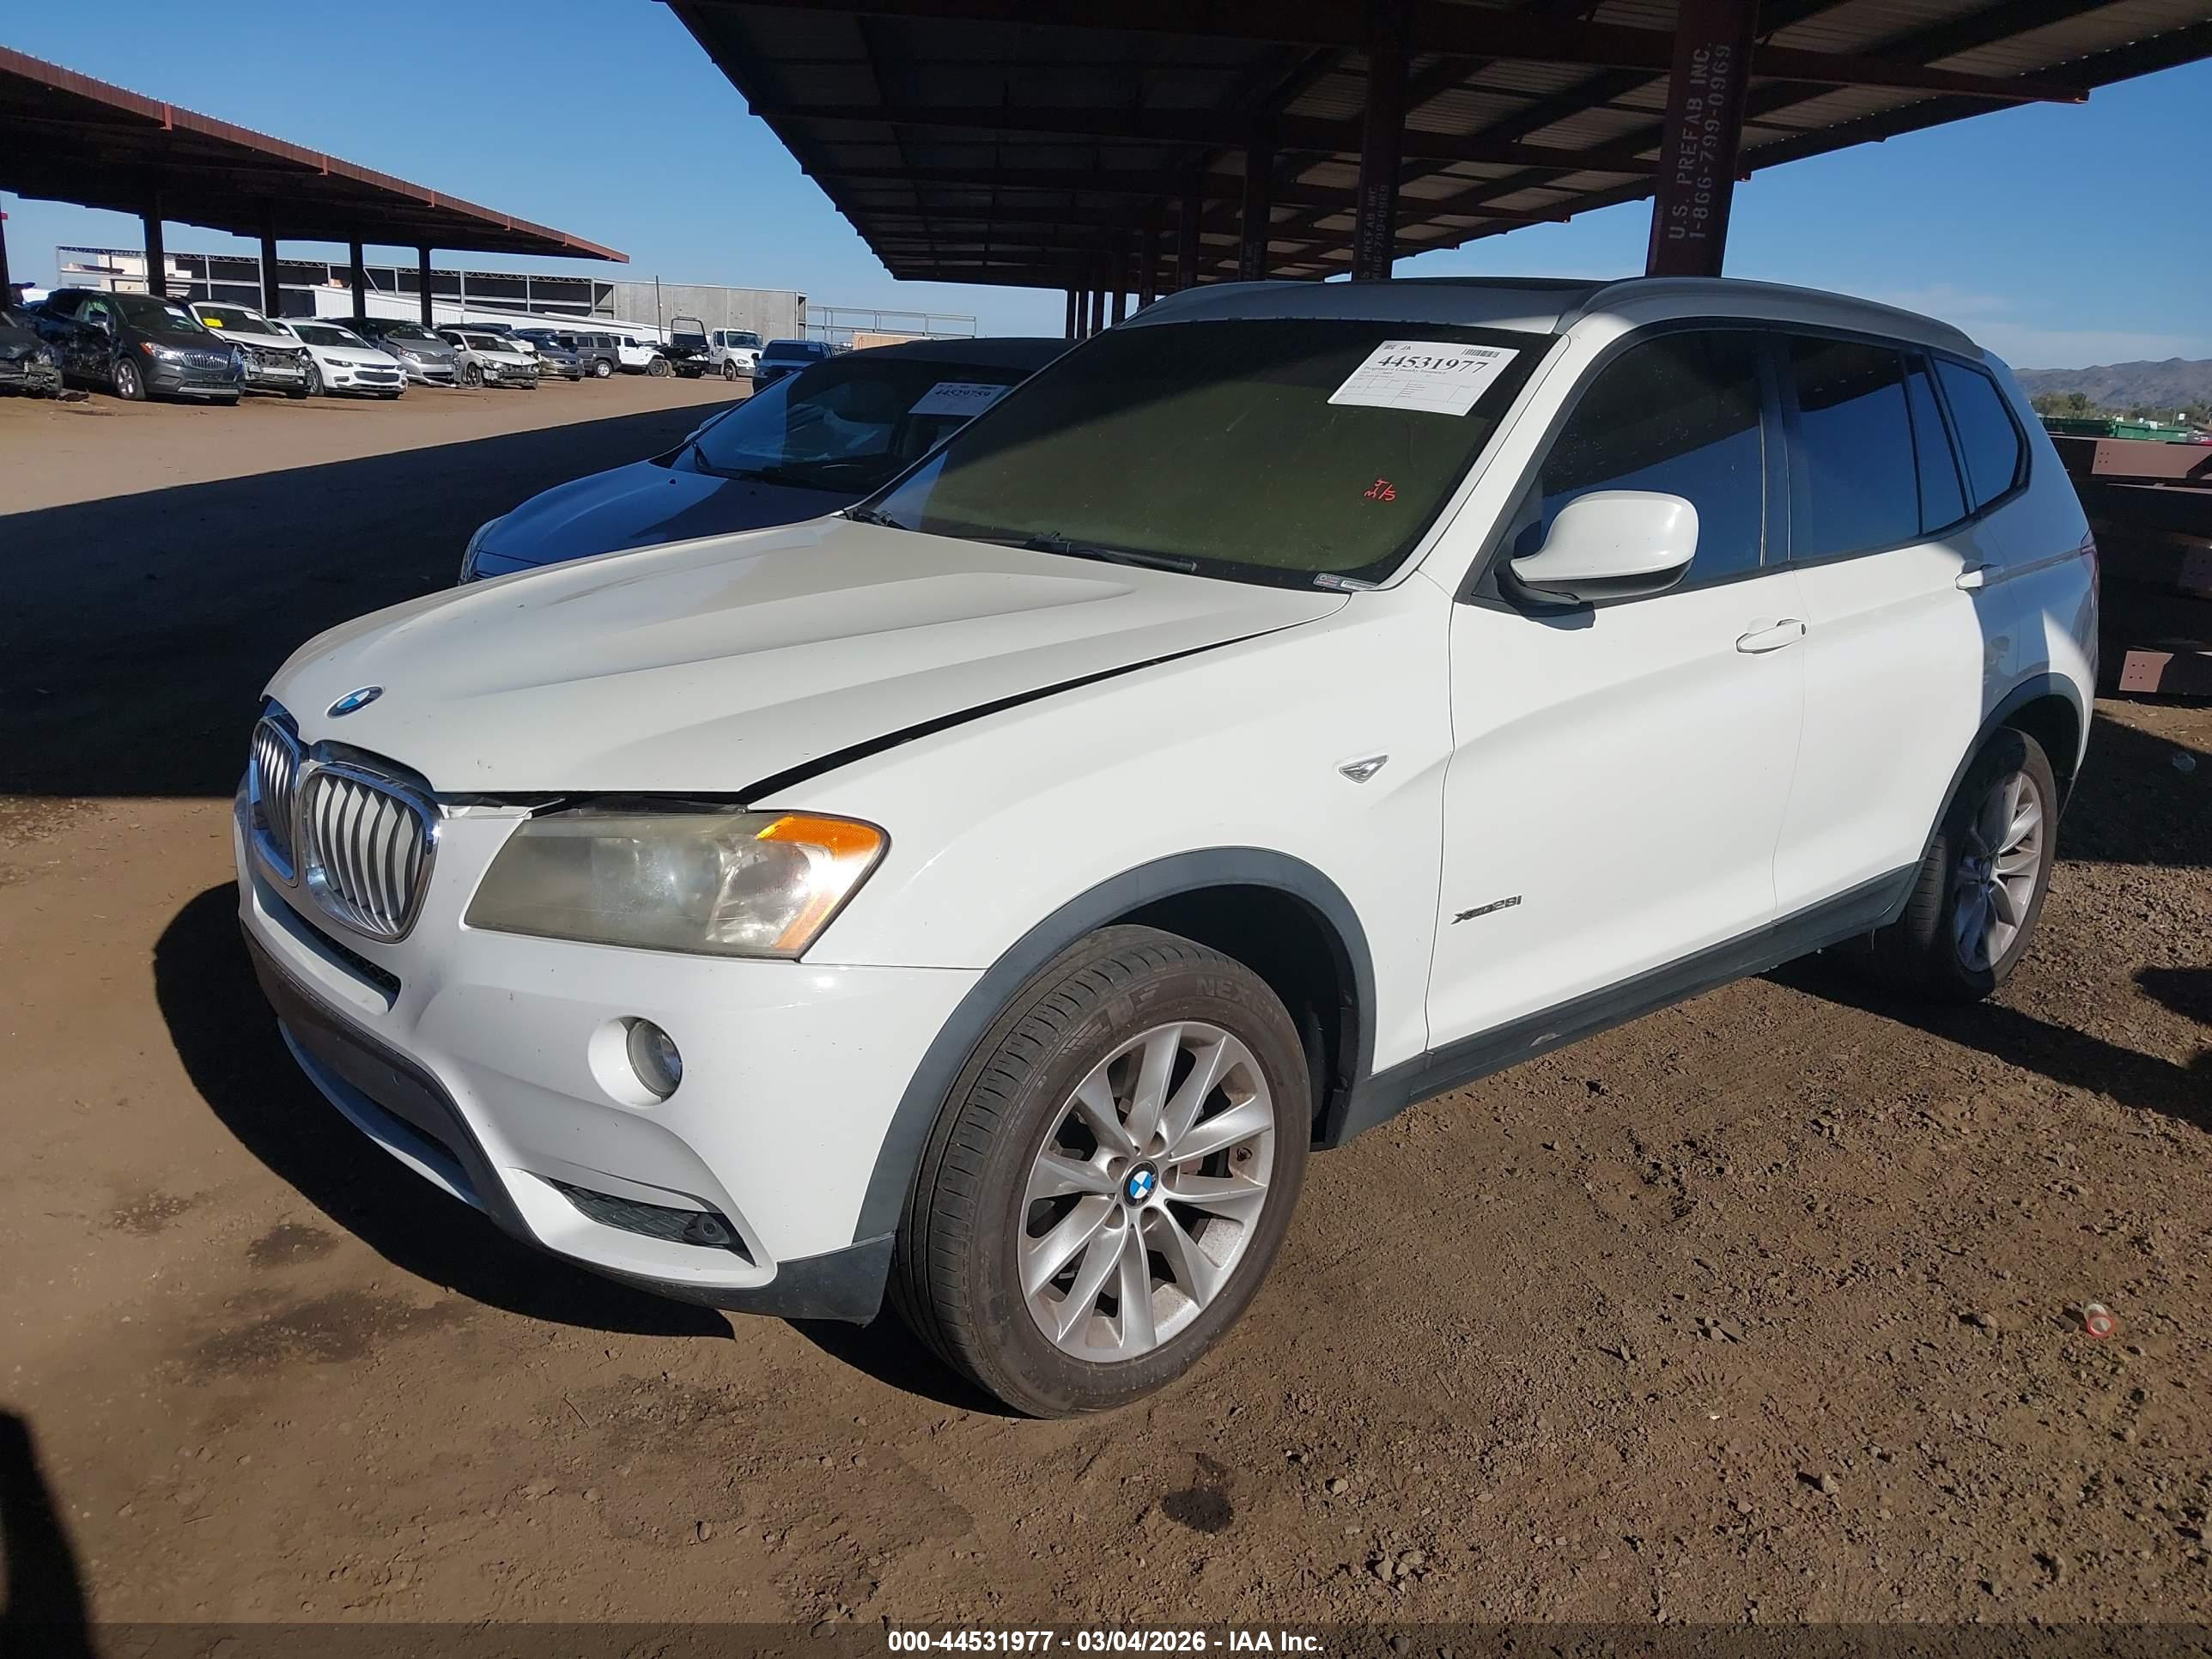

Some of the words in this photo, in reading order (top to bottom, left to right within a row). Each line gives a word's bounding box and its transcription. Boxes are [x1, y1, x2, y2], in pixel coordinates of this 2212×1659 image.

[1690, 43, 1711, 84] INC.
[1676, 97, 1703, 185] PREFAB
[1689, 44, 1731, 240] 1-866-799-0969
[1668, 198, 1689, 240] U.S.
[1377, 354, 1488, 374] 44531977
